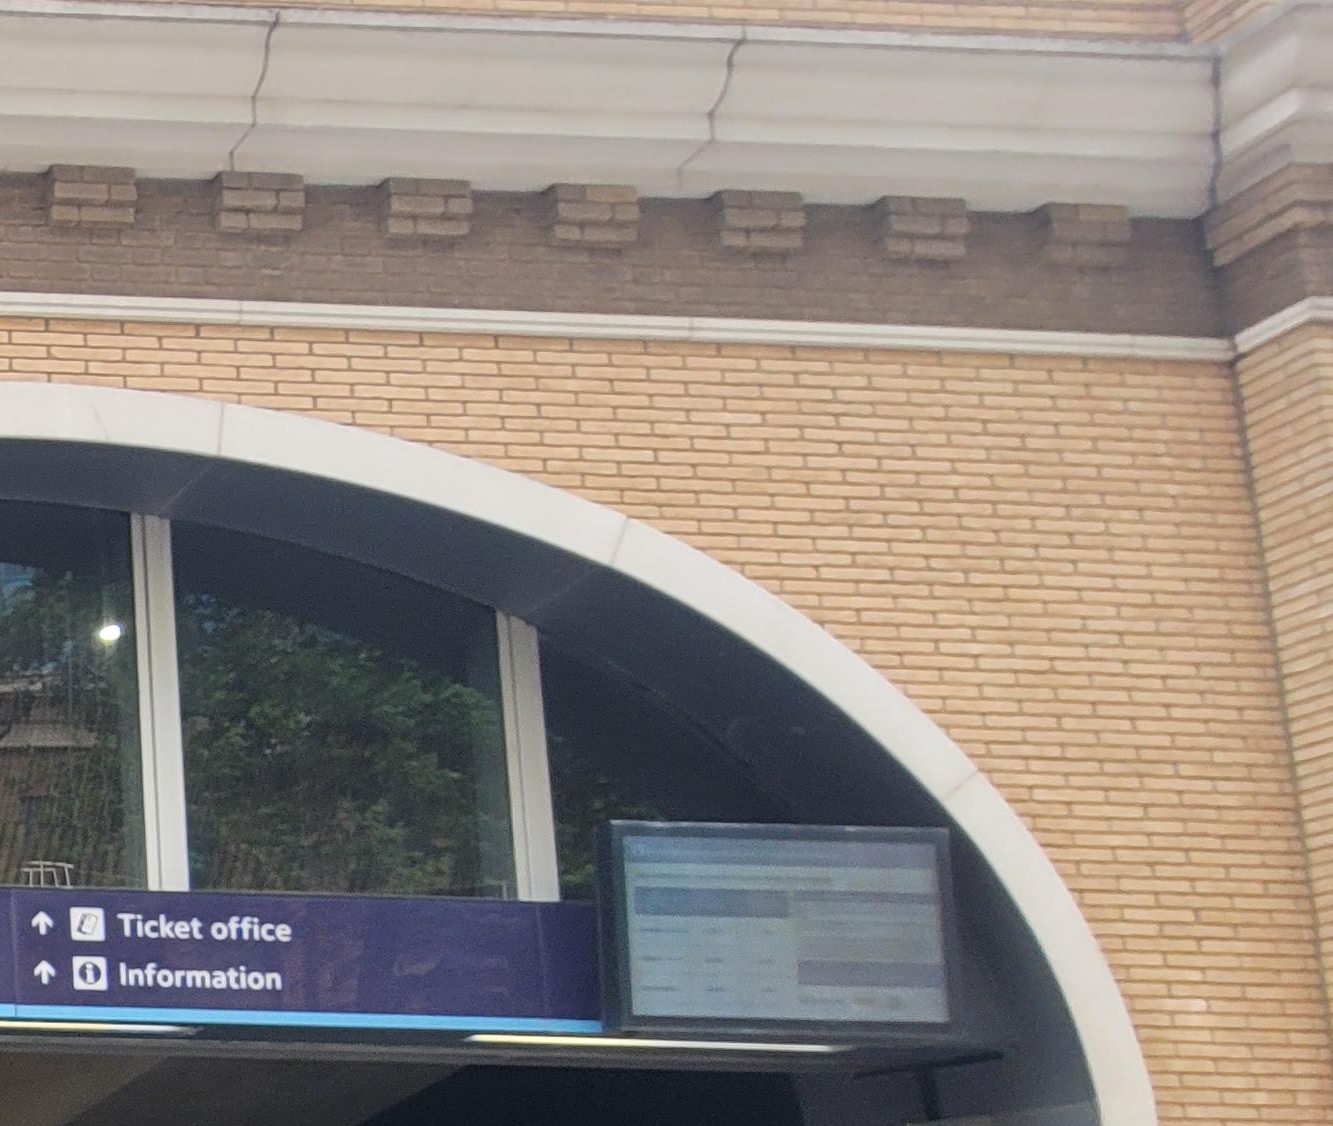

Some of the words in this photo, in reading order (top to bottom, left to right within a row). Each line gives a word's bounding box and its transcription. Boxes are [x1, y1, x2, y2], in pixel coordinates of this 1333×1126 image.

[117, 912, 203, 941] Ticket
[210, 915, 293, 943] office
[119, 961, 283, 991] Information
